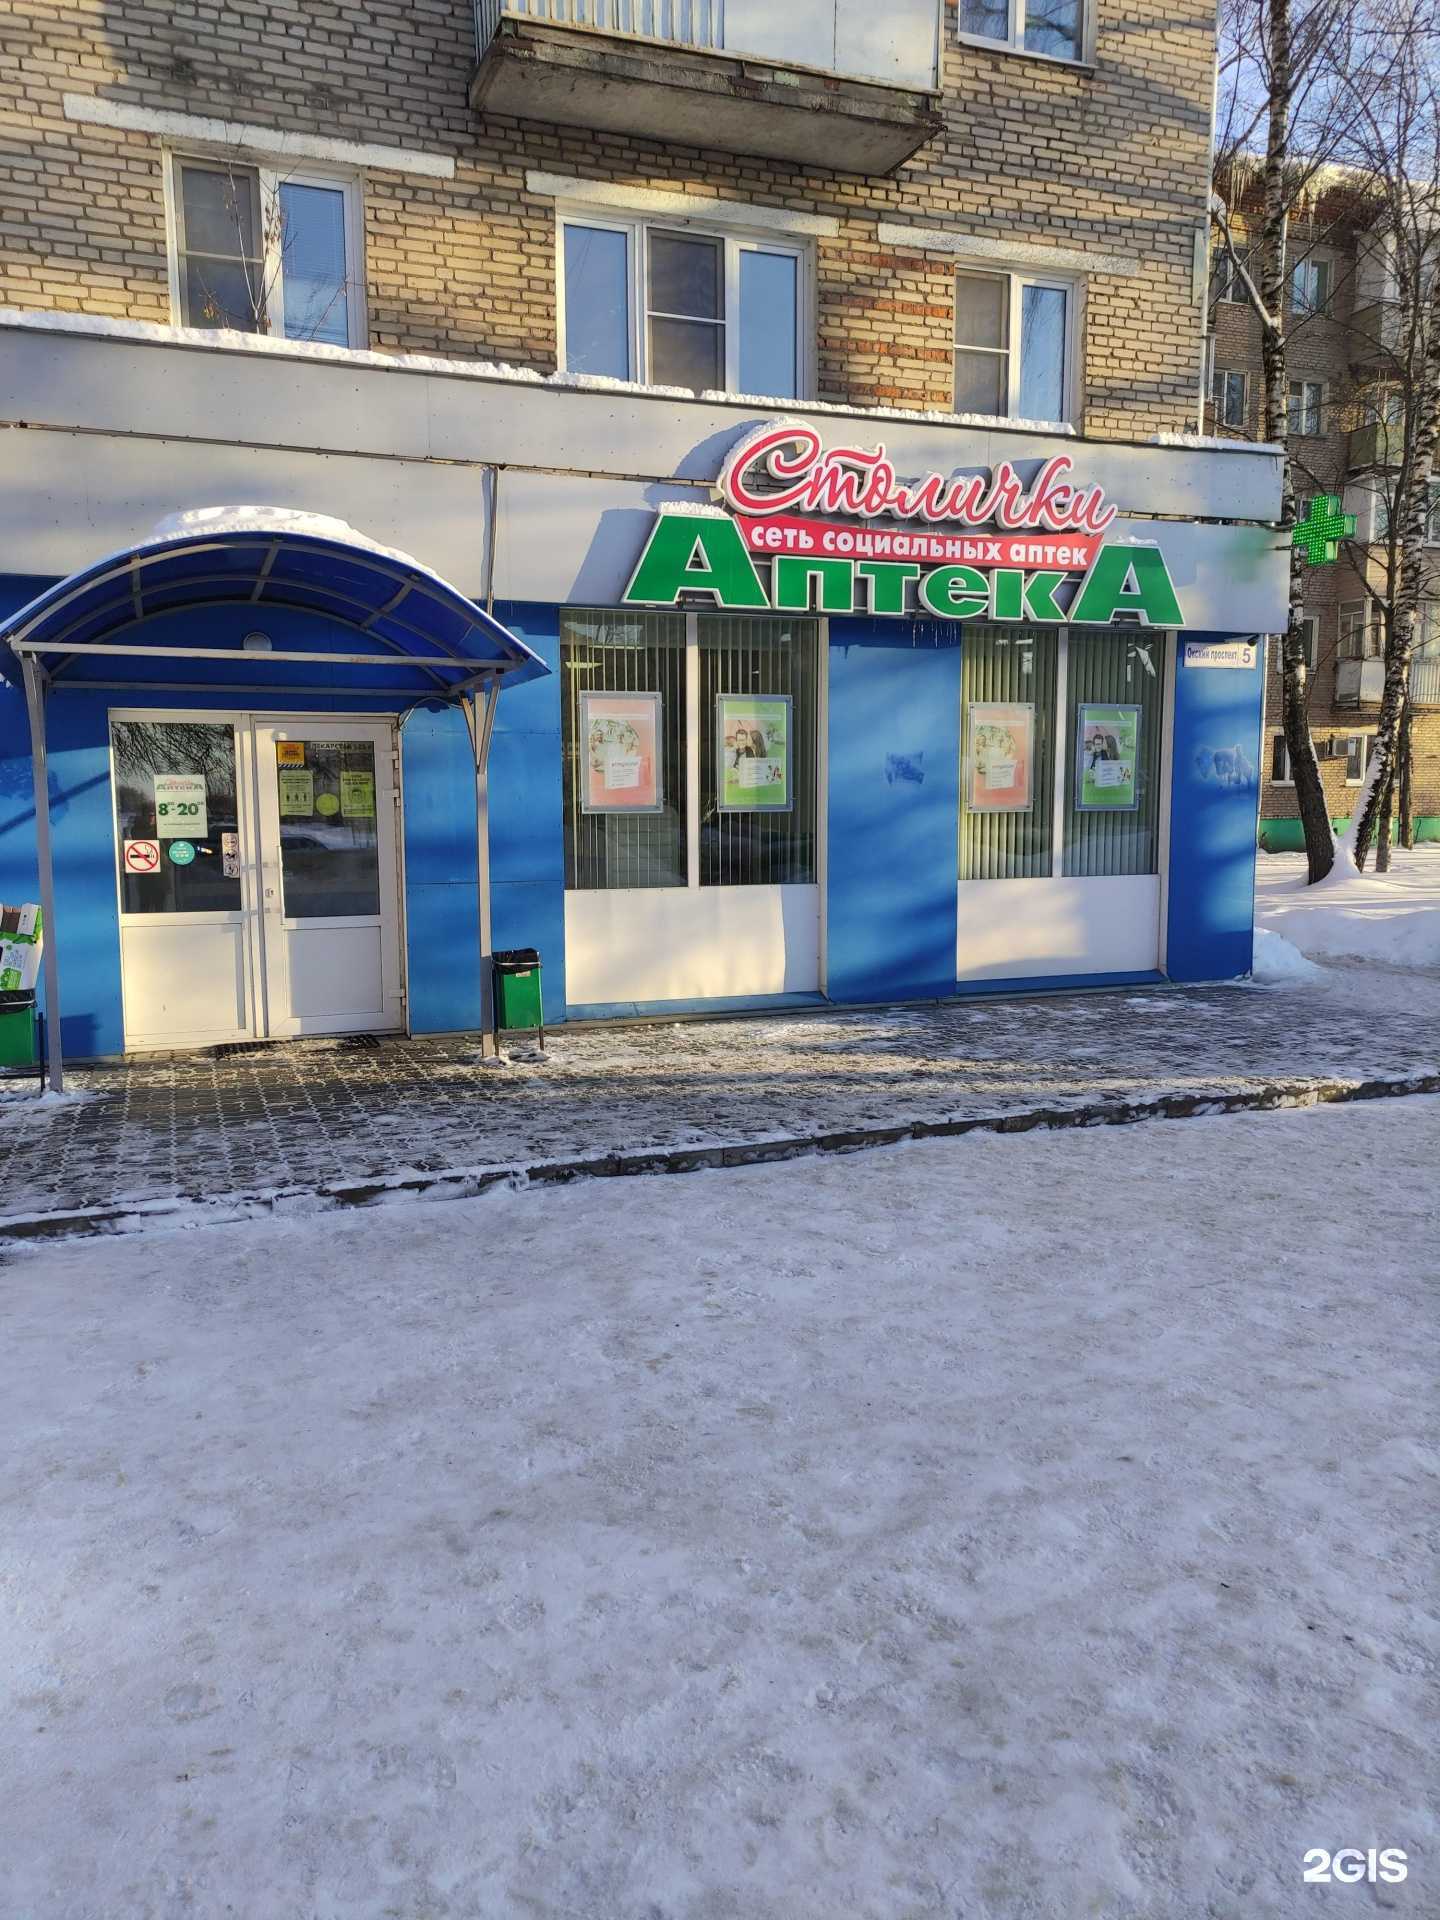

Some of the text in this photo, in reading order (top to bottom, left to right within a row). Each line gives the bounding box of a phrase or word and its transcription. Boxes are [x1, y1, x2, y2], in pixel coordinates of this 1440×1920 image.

[724, 425, 1118, 536] Столички
[750, 525, 1088, 566] сеть социальных аптек
[1242, 647, 1252, 664] 5
